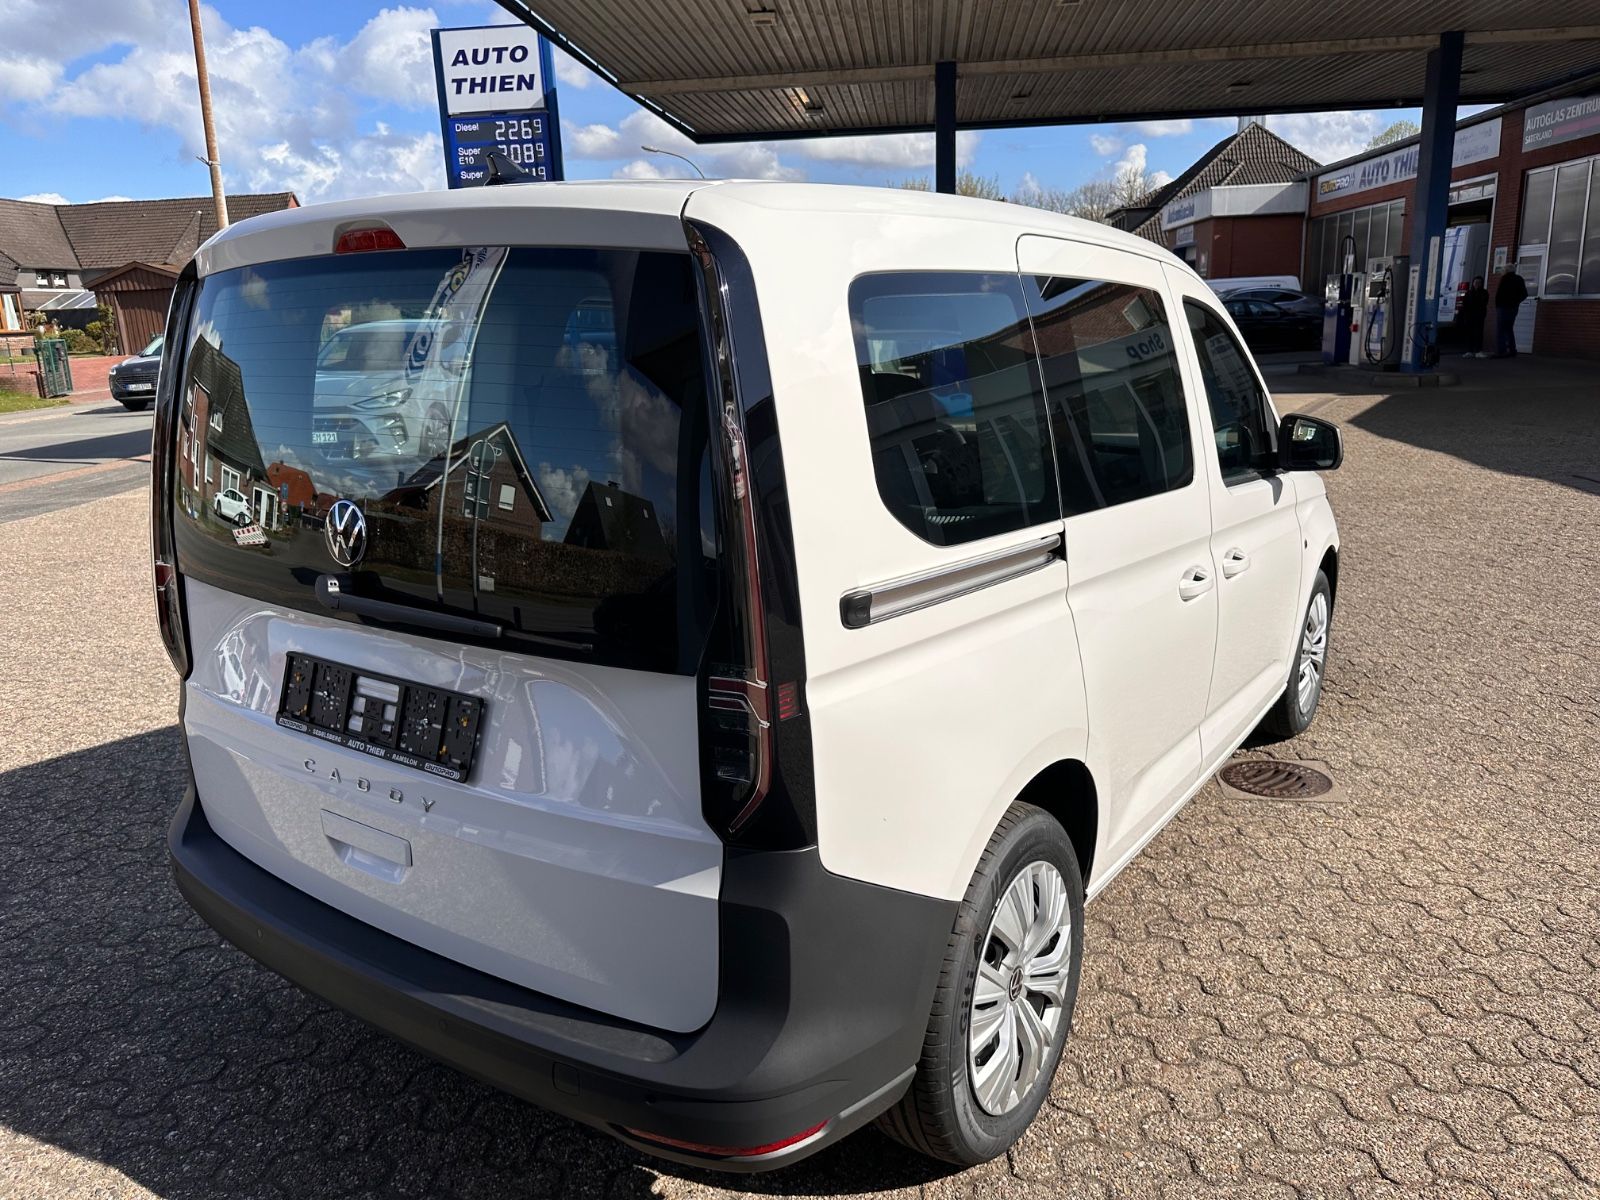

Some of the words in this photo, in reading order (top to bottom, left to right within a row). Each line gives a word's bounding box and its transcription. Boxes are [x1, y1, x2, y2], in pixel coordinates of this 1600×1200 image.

[451, 45, 529, 67] AUTO
[451, 73, 535, 95] THIEN
[1525, 108, 1566, 131] AUTOGLAS
[1566, 97, 1600, 119] ZENTRU
[455, 123, 480, 132] Diesel
[458, 147, 481, 156] Super
[459, 156, 475, 165] E10
[460, 171, 484, 180] Super
[1359, 160, 1390, 189] AUTO
[1393, 150, 1419, 178] THIE
[347, 739, 366, 751] AUTO
[366, 744, 386, 757] THIEN
[304, 758, 436, 813] CADDY
